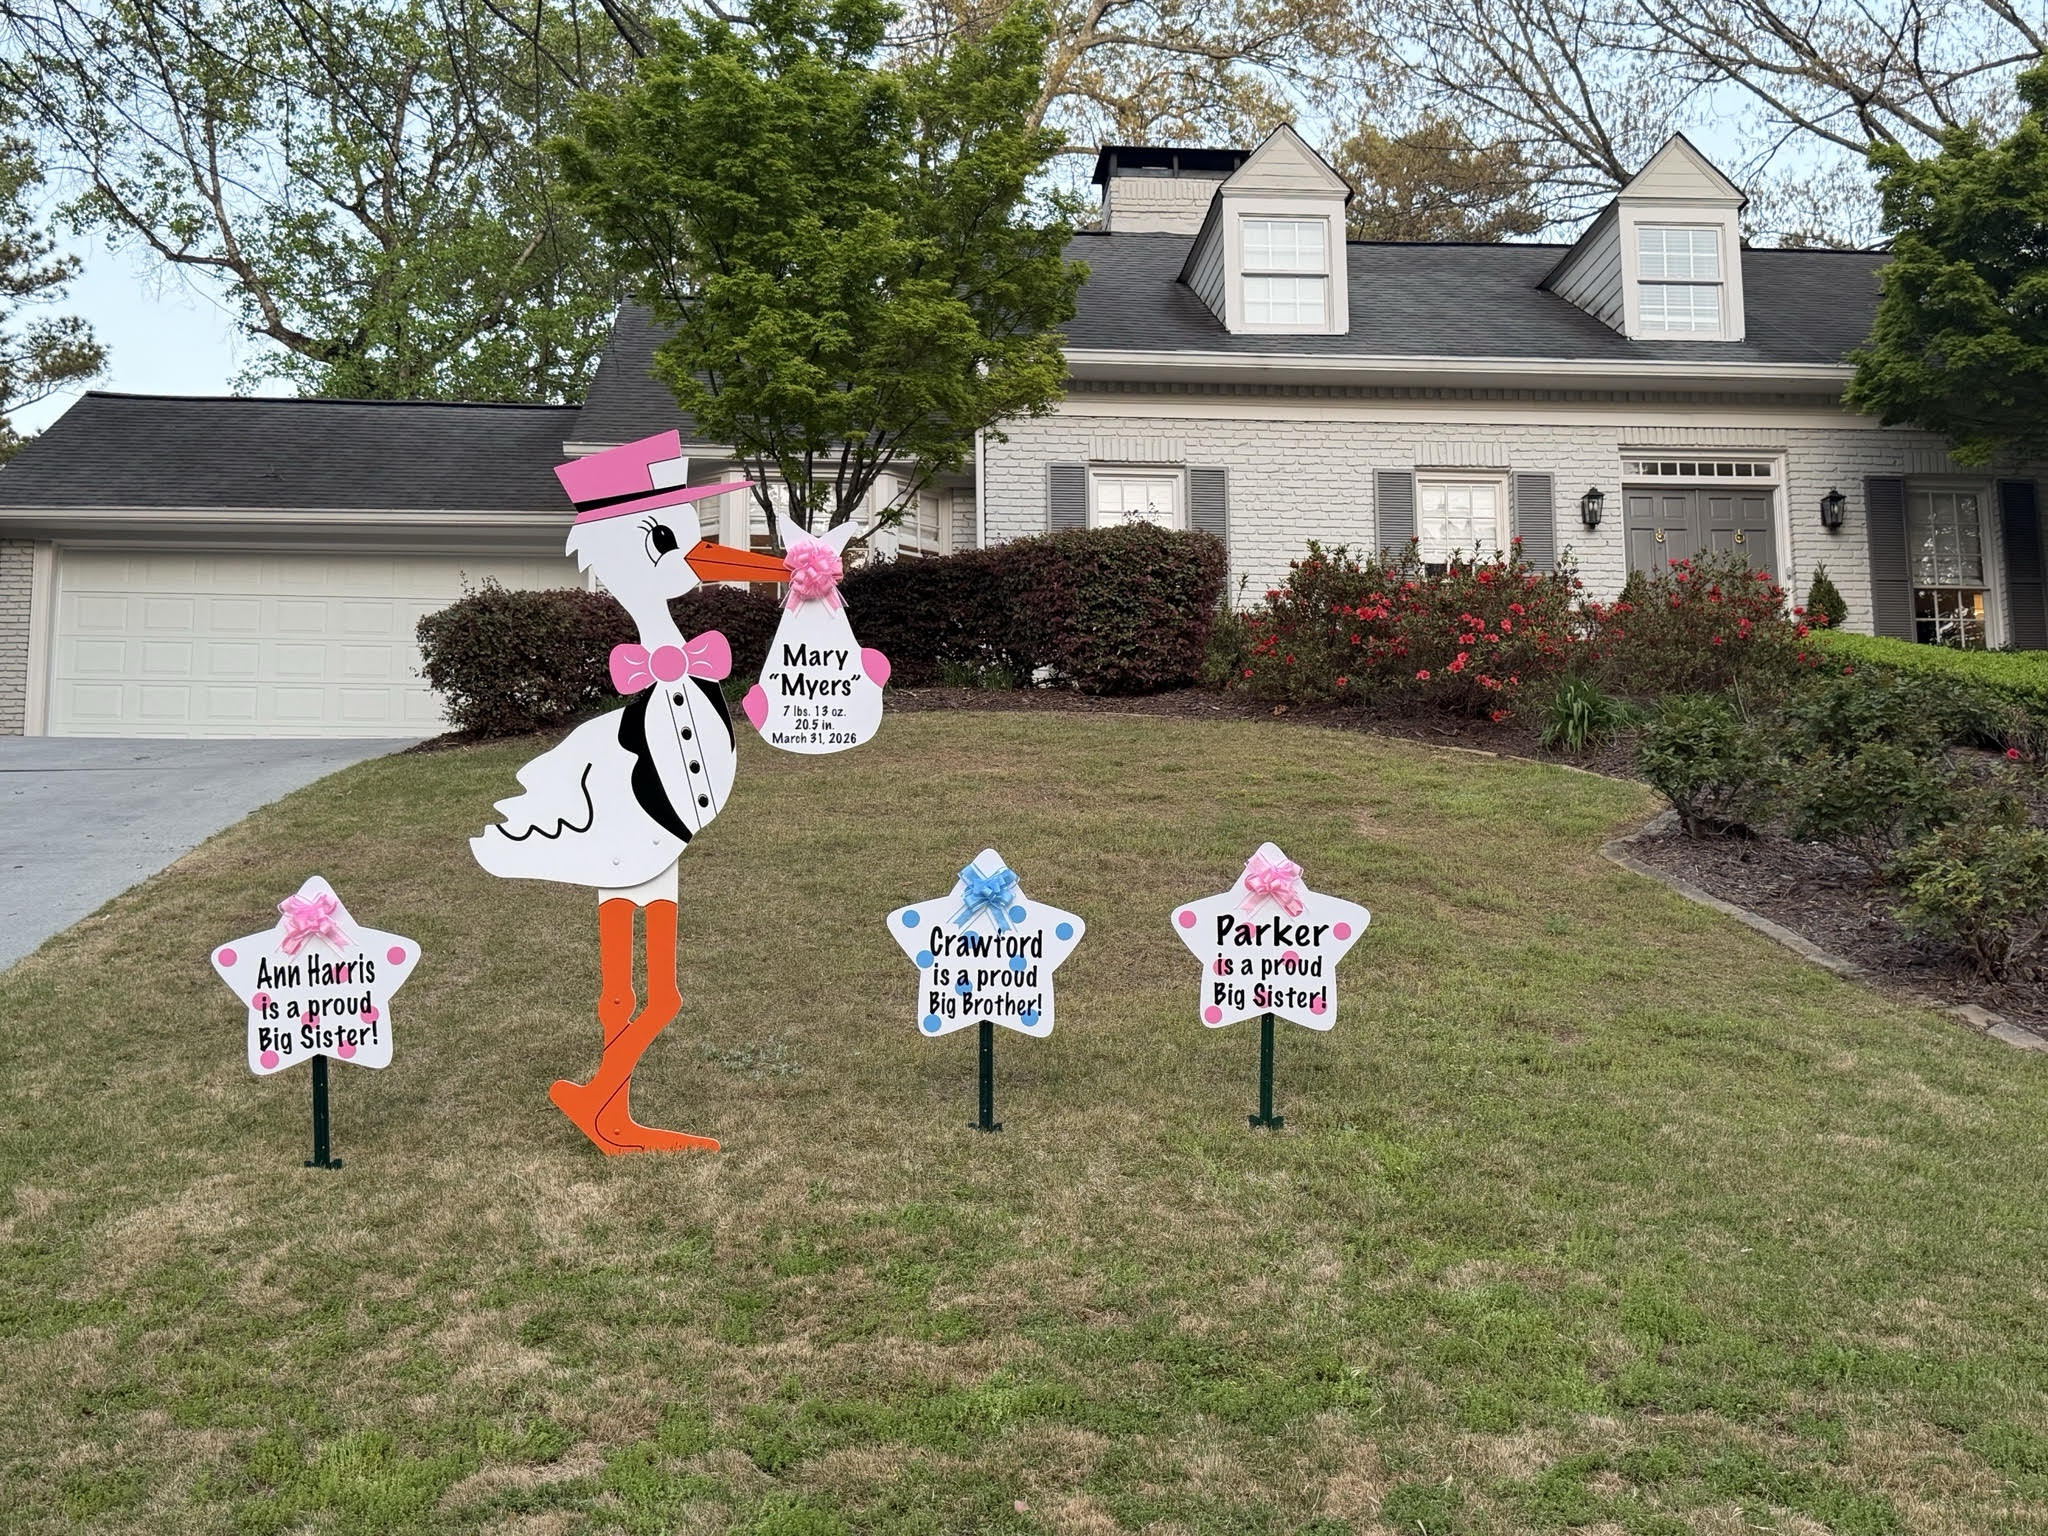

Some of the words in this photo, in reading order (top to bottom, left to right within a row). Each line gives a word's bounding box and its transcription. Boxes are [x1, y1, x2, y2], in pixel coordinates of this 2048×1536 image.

[783, 643, 848, 671] Mary
[769, 673, 861, 700] “Myers”
[783, 705, 790, 716] 7
[793, 705, 811, 717] lbs.
[815, 705, 829, 717] 13
[831, 708, 846, 717] oz.
[795, 719, 819, 730] 20.5
[822, 719, 835, 730] in.
[772, 733, 807, 744] March
[810, 733, 825, 745] 31,
[828, 733, 857, 744] 2026
[930, 925, 1043, 959] Crawford
[1216, 914, 1329, 947] Parker
[256, 957, 301, 989] Ann
[307, 953, 375, 987] Harris
[933, 963, 950, 986] is
[956, 969, 970, 986] a
[977, 965, 1038, 991] proud
[1217, 953, 1234, 976] is
[1241, 958, 1253, 975] a
[1261, 955, 1322, 980] proud
[261, 996, 279, 1020] is
[287, 1000, 300, 1019] a
[308, 990, 372, 1022] proud
[929, 991, 956, 1019] Big
[962, 992, 1042, 1017] Brother!
[1214, 982, 1245, 1010] Big
[1252, 983, 1327, 1009] Sister!
[258, 1027, 293, 1054] Big
[300, 1021, 378, 1049] Sister!
